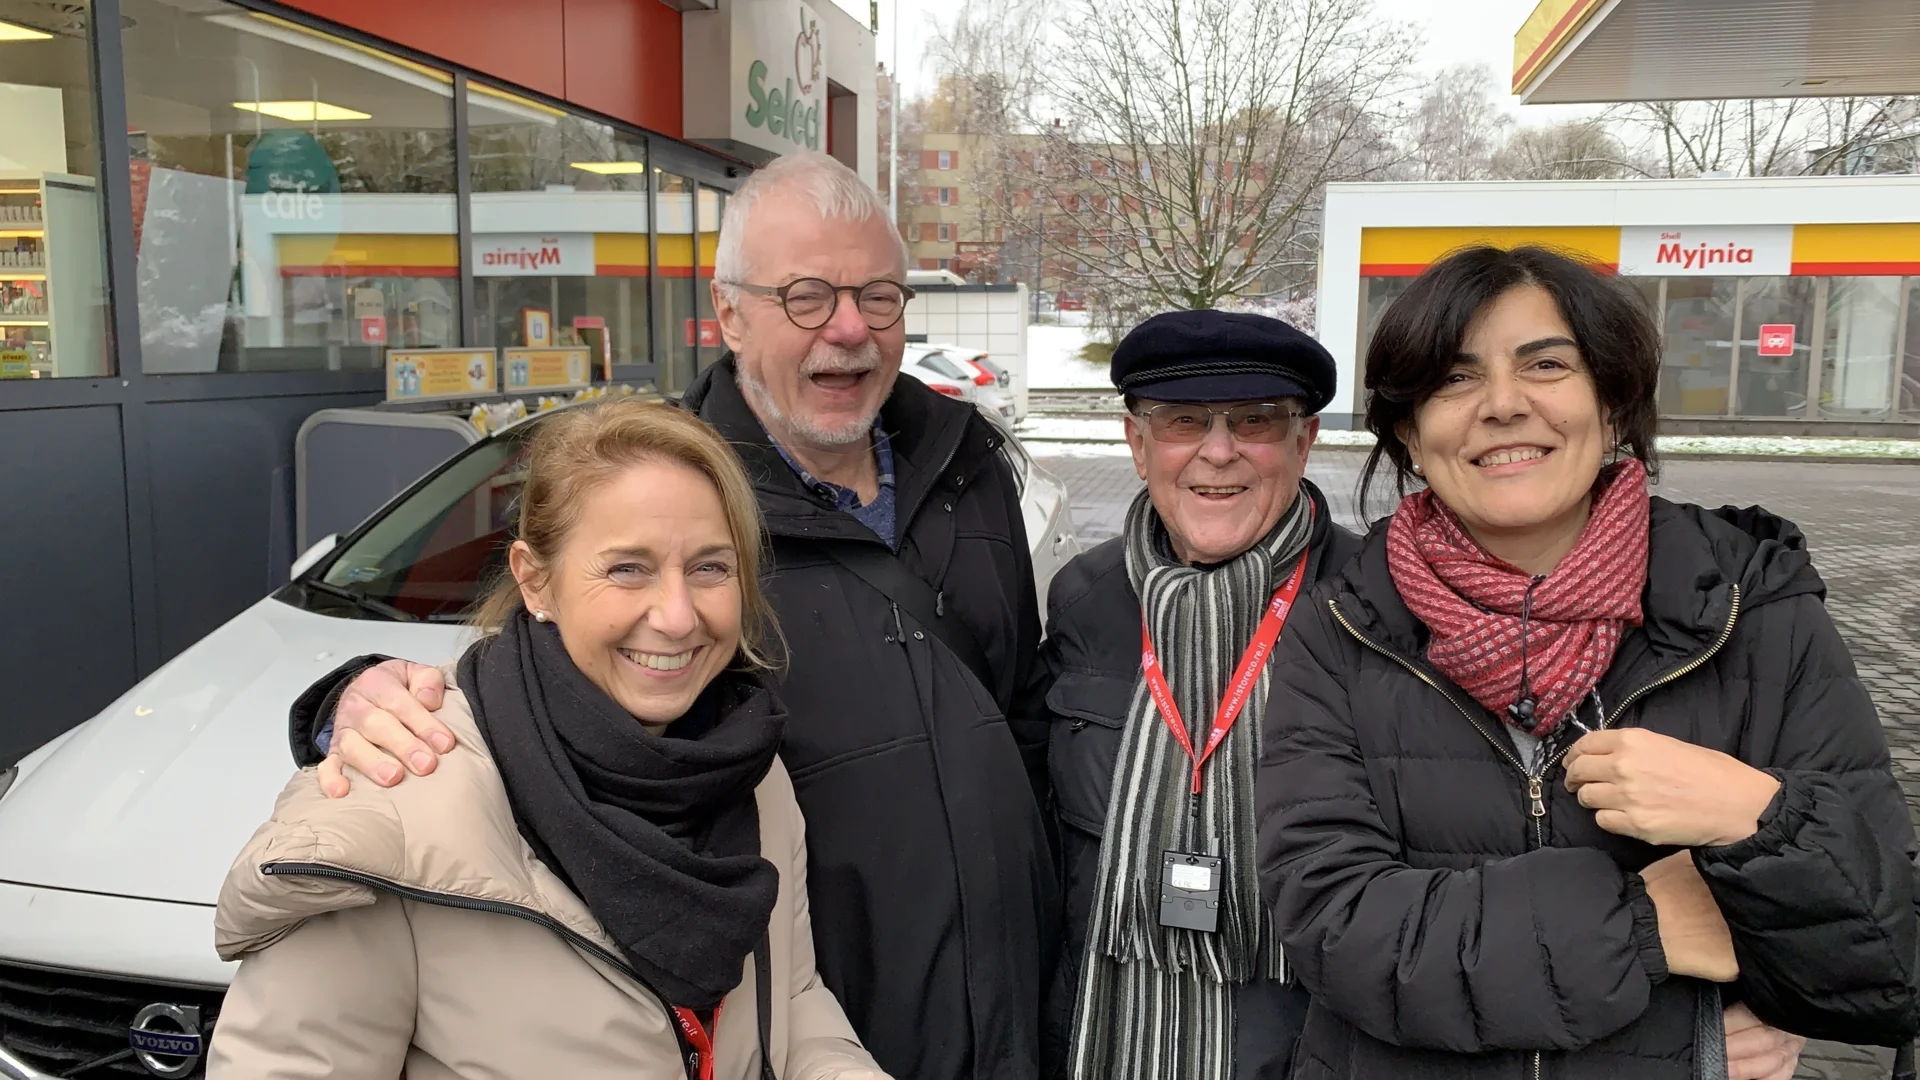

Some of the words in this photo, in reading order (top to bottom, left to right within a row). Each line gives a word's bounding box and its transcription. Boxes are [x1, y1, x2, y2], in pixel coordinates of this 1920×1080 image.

[745, 59, 820, 151] Select
[1660, 232, 1682, 240] Shell
[1656, 242, 1754, 270] Myjnia
[1224, 641, 1268, 719] www.istoreco.re.it
[133, 1034, 194, 1052] VOLVO
